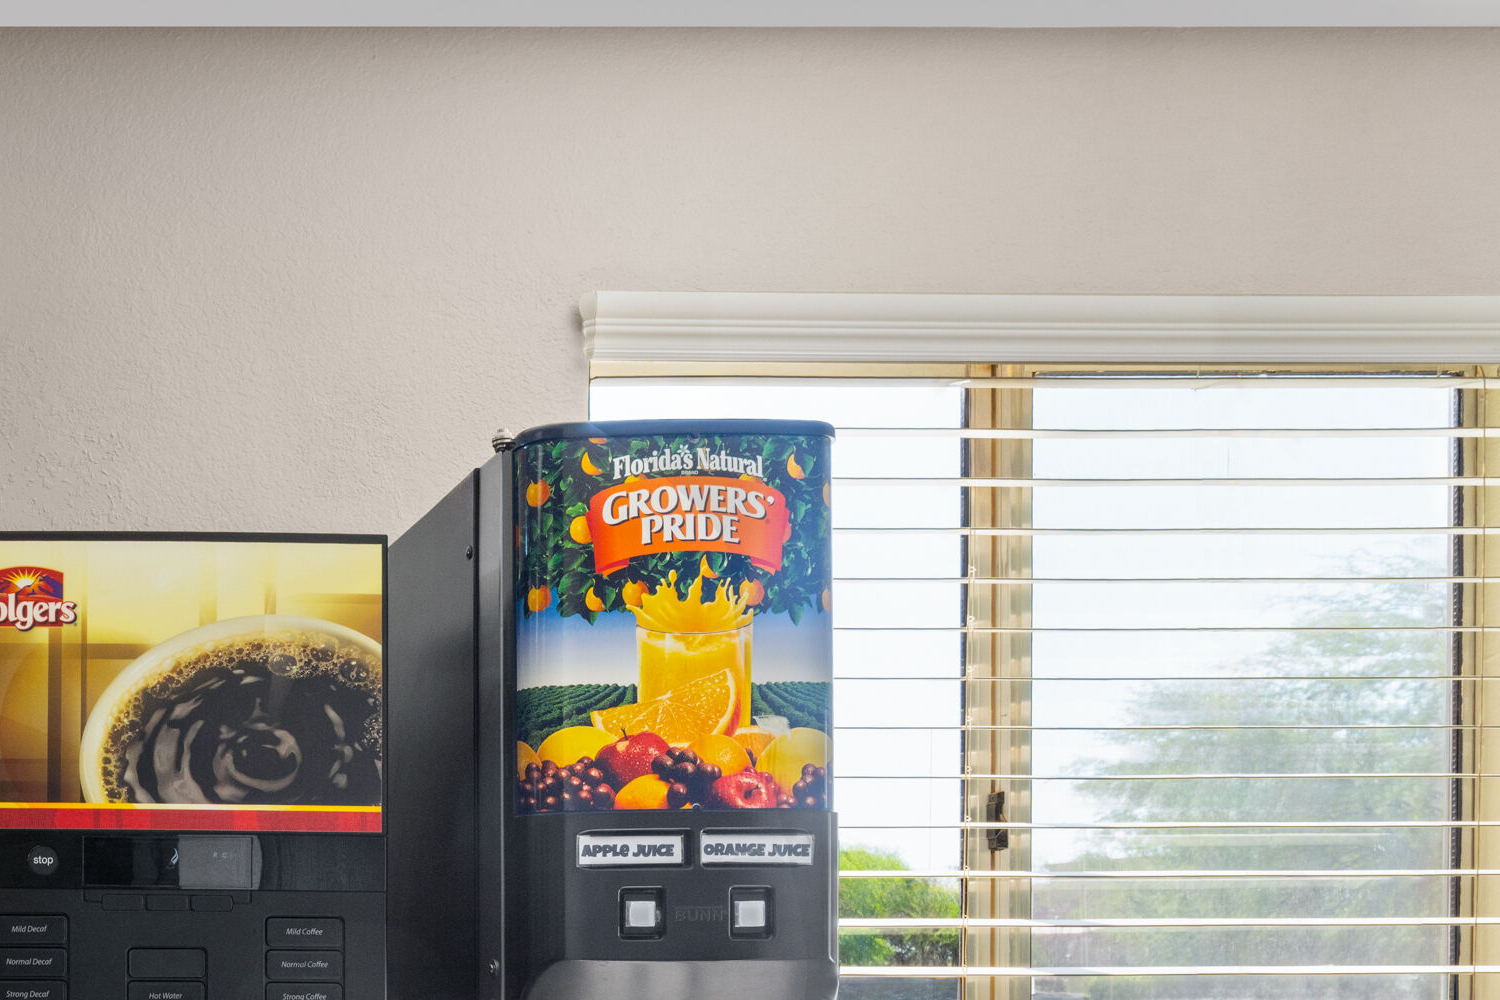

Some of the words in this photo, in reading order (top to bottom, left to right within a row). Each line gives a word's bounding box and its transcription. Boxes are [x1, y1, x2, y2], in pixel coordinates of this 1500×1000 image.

[612, 446, 693, 480] Florida's
[697, 447, 763, 478] Natural
[602, 484, 775, 525] GROWERS'
[641, 513, 740, 545] PRIDE
[632, 844, 675, 857] JUICE
[703, 843, 766, 857] ORANGE
[767, 843, 810, 857] JUICE
[33, 855, 54, 866] stop
[675, 910, 724, 922] BUNN
[11, 925, 26, 933] Mild
[27, 924, 47, 933] Decaf
[286, 928, 301, 936] Mild
[302, 928, 324, 936] Coffee
[6, 957, 31, 966] Normal
[32, 957, 52, 965] Decaf
[307, 960, 329, 968] Coffee
[6, 990, 29, 999] Strong
[29, 990, 50, 998] Decaf
[149, 992, 162, 1000] Hot
[163, 992, 182, 1000] Water
[305, 993, 328, 1000] Coffee
